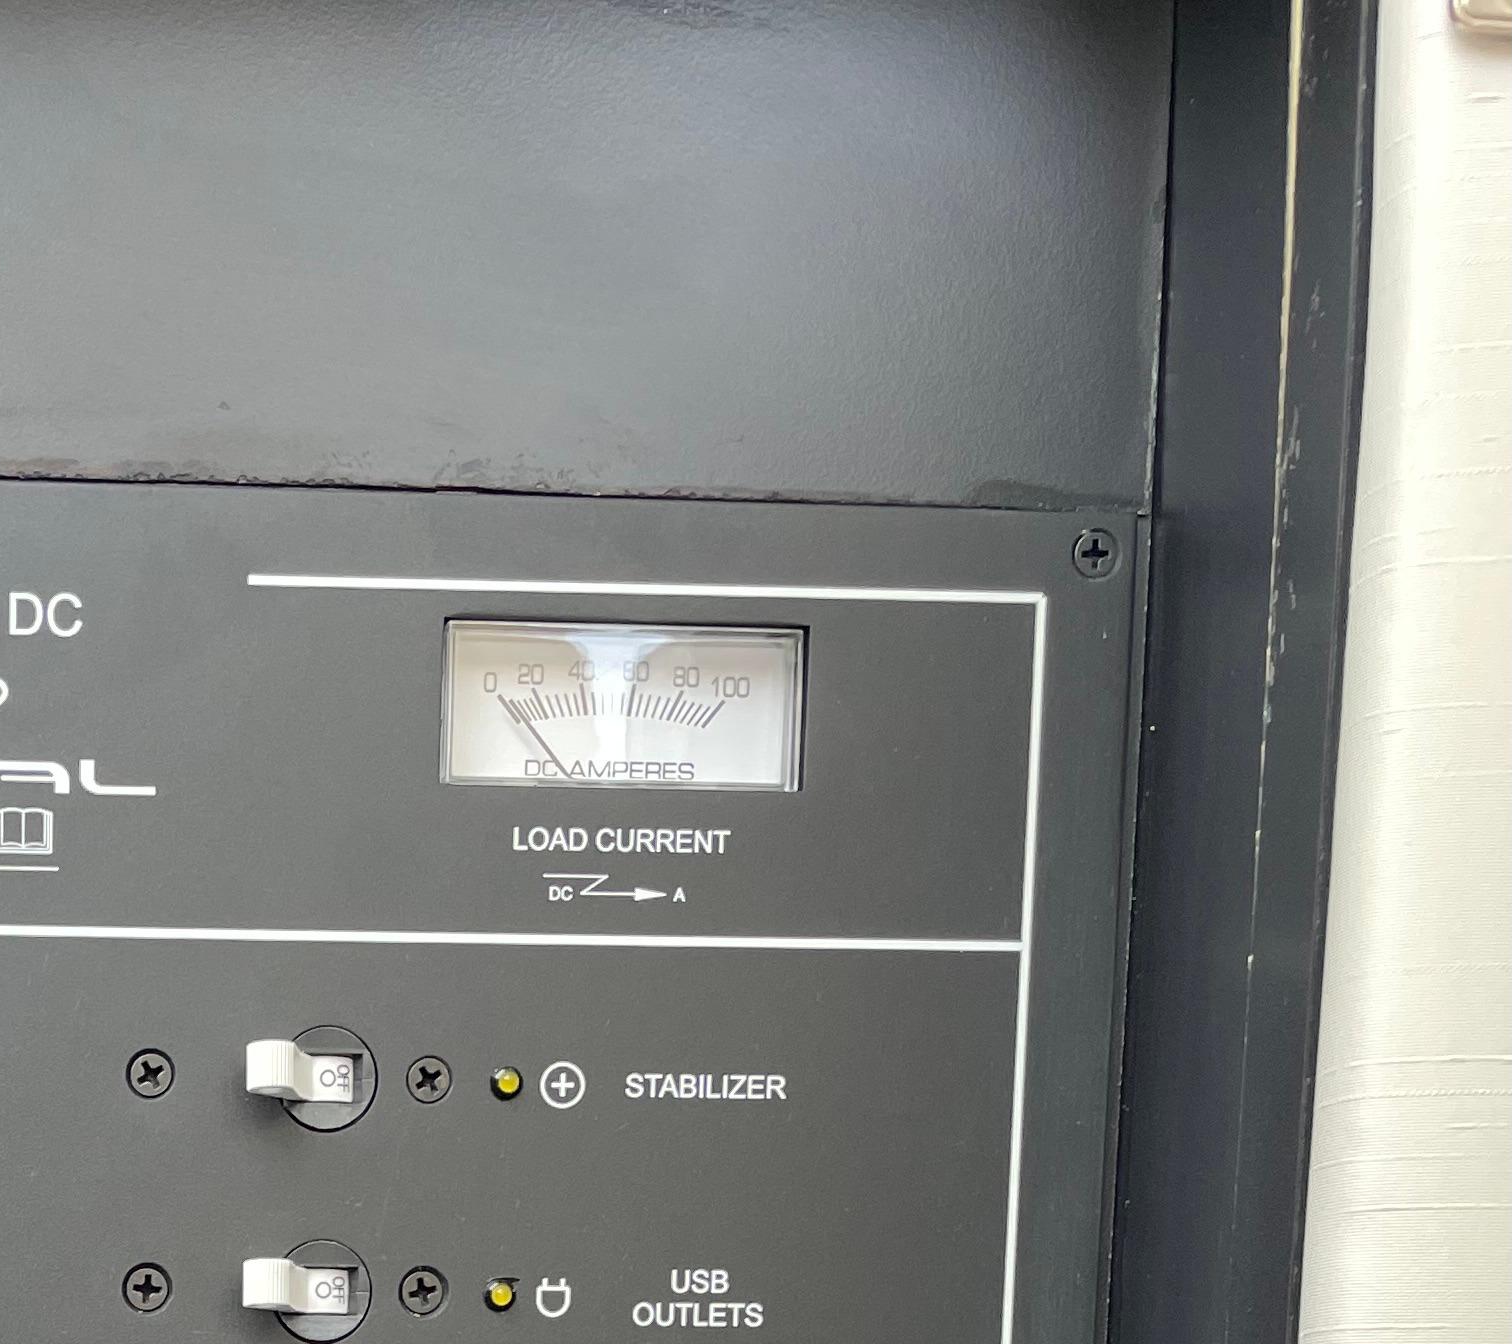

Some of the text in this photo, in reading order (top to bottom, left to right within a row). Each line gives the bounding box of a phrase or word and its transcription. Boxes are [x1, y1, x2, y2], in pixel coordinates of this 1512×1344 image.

[8, 591, 83, 638] DC
[484, 660, 750, 698] 0 20 40 60 80 100
[524, 759, 694, 780] DC AMPERES
[512, 826, 732, 854] LOAD CURRENT
[548, 885, 686, 903] DC A
[624, 1072, 787, 1100] STABILIZER
[670, 1268, 730, 1294] USB
[632, 1301, 764, 1328] OUTLETS
